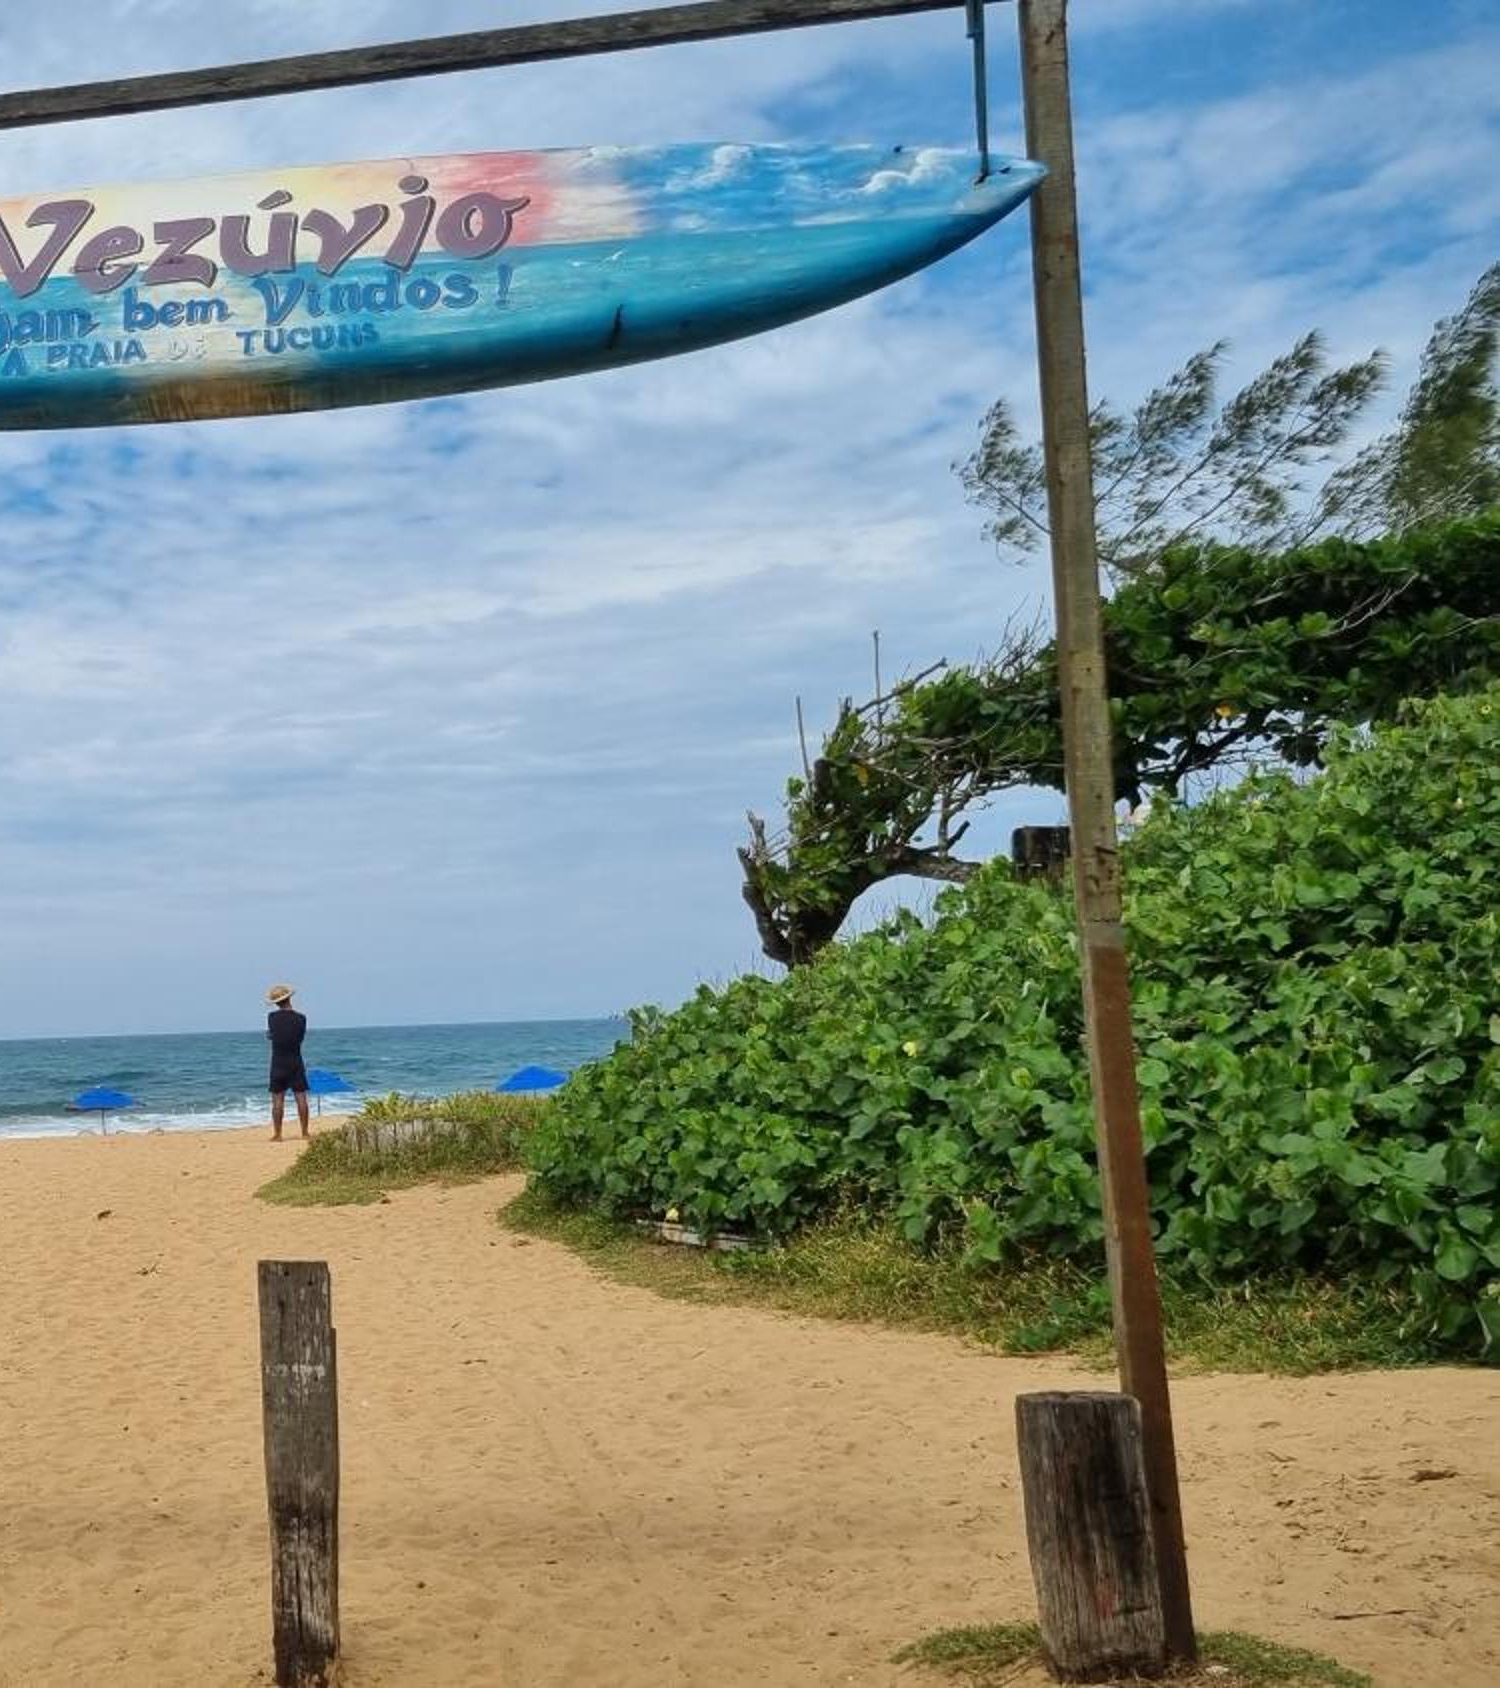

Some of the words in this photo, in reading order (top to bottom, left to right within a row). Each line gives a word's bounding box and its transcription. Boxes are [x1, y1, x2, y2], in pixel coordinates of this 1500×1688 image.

[123, 286, 235, 332] bem
[48, 338, 147, 370] PRAIA
[235, 321, 380, 356] TUCUNS
